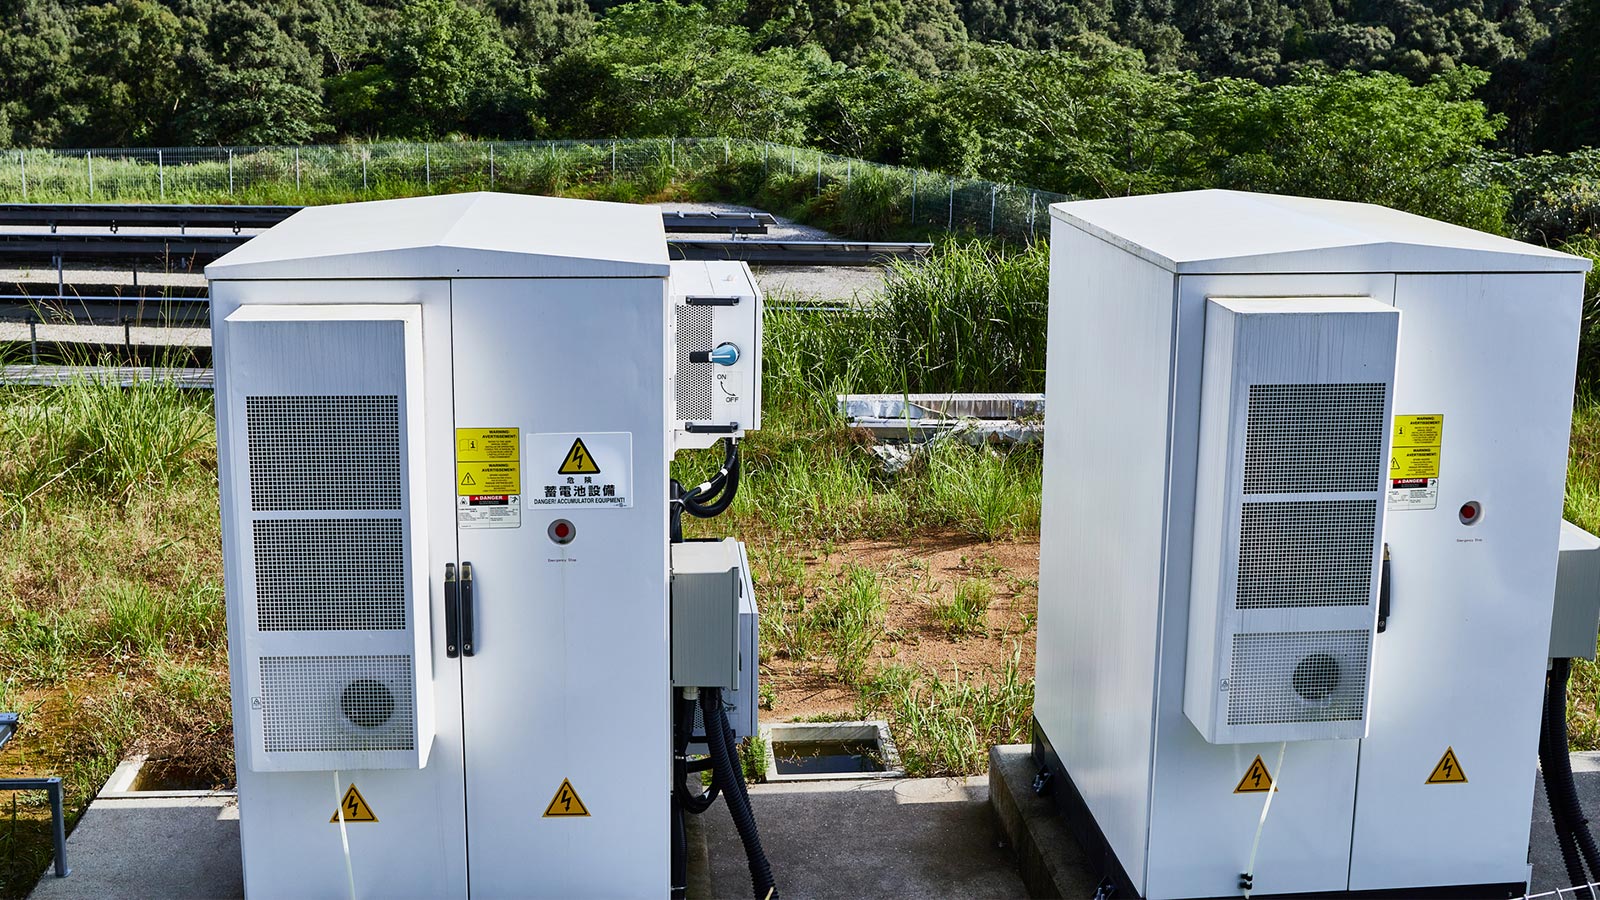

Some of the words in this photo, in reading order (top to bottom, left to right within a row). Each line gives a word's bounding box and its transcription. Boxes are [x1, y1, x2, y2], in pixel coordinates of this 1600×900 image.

[544, 484, 615, 498] 蓄電池設備
